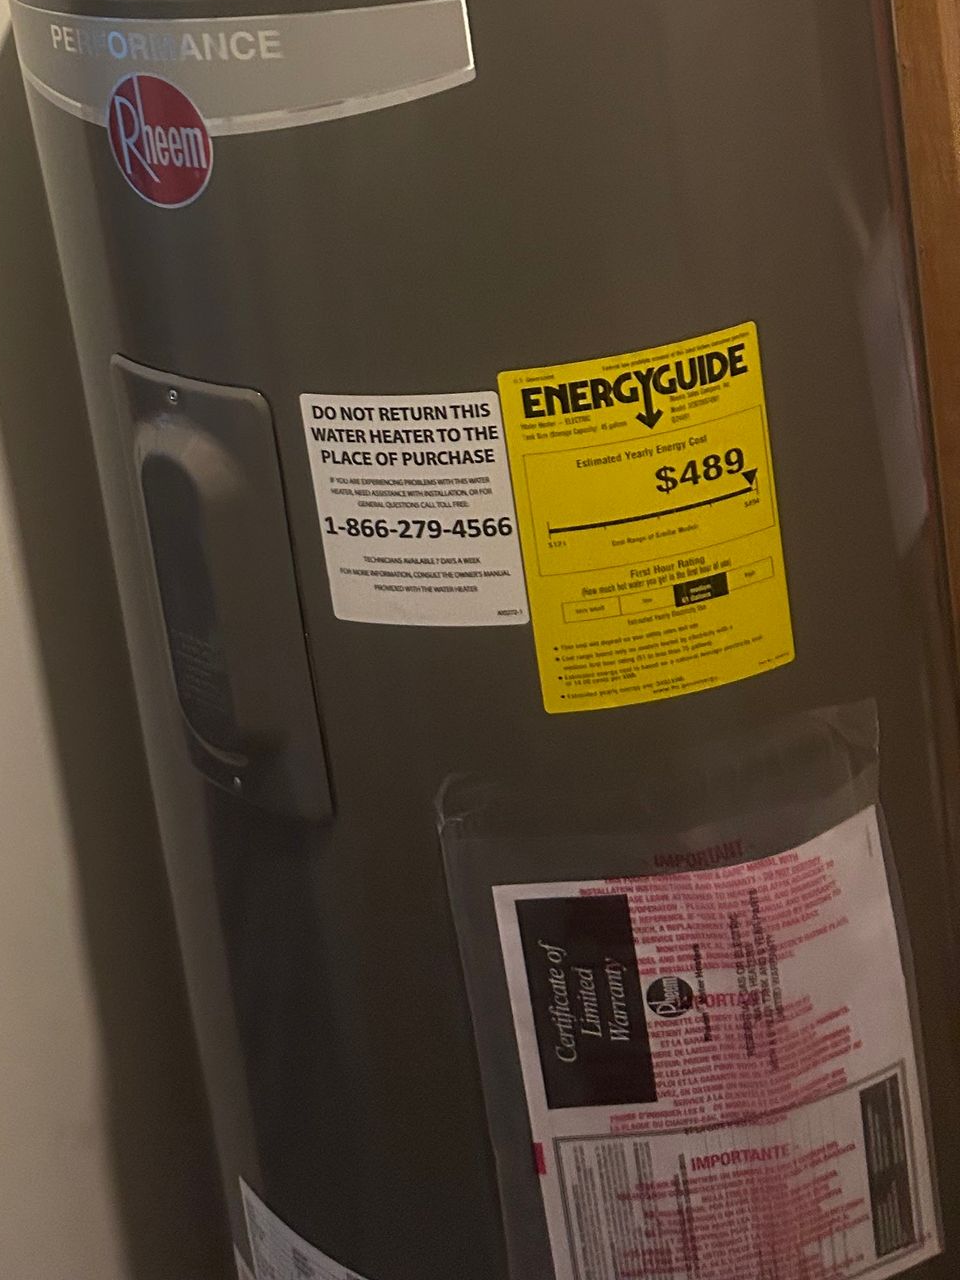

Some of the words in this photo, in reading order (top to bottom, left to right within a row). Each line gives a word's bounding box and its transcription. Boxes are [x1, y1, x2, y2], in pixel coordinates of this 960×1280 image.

[50, 23, 285, 61] PERFORMANCE
[112, 75, 208, 183] Rheem
[522, 345, 746, 417] ENERGYGUIDE
[311, 405, 337, 420] DO
[339, 406, 374, 421] NOT
[378, 405, 447, 421] RETURN
[449, 403, 490, 419] THIS
[310, 427, 366, 443] WATER
[369, 429, 434, 444] HEATER
[435, 428, 461, 442] TO
[462, 425, 499, 441] THE
[320, 449, 372, 465] PLACE
[375, 451, 398, 466] OF
[401, 448, 494, 466] PURCHASE
[576, 453, 622, 468] Estimated
[624, 447, 653, 460] Yearly
[655, 441, 686, 454] Energy
[688, 434, 707, 446] Cost
[468, 476, 490, 484] WATER
[655, 448, 747, 493] $489
[325, 516, 512, 538] 1-866-279-4566
[629, 567, 651, 578] First
[652, 563, 674, 574] Hour
[677, 556, 705, 569] Rating
[537, 939, 567, 963] of
[571, 967, 602, 1036] Limited
[605, 957, 629, 1040] Warranty
[548, 968, 576, 1062] Certificate
[691, 1146, 790, 1171] IMPORTANTE
